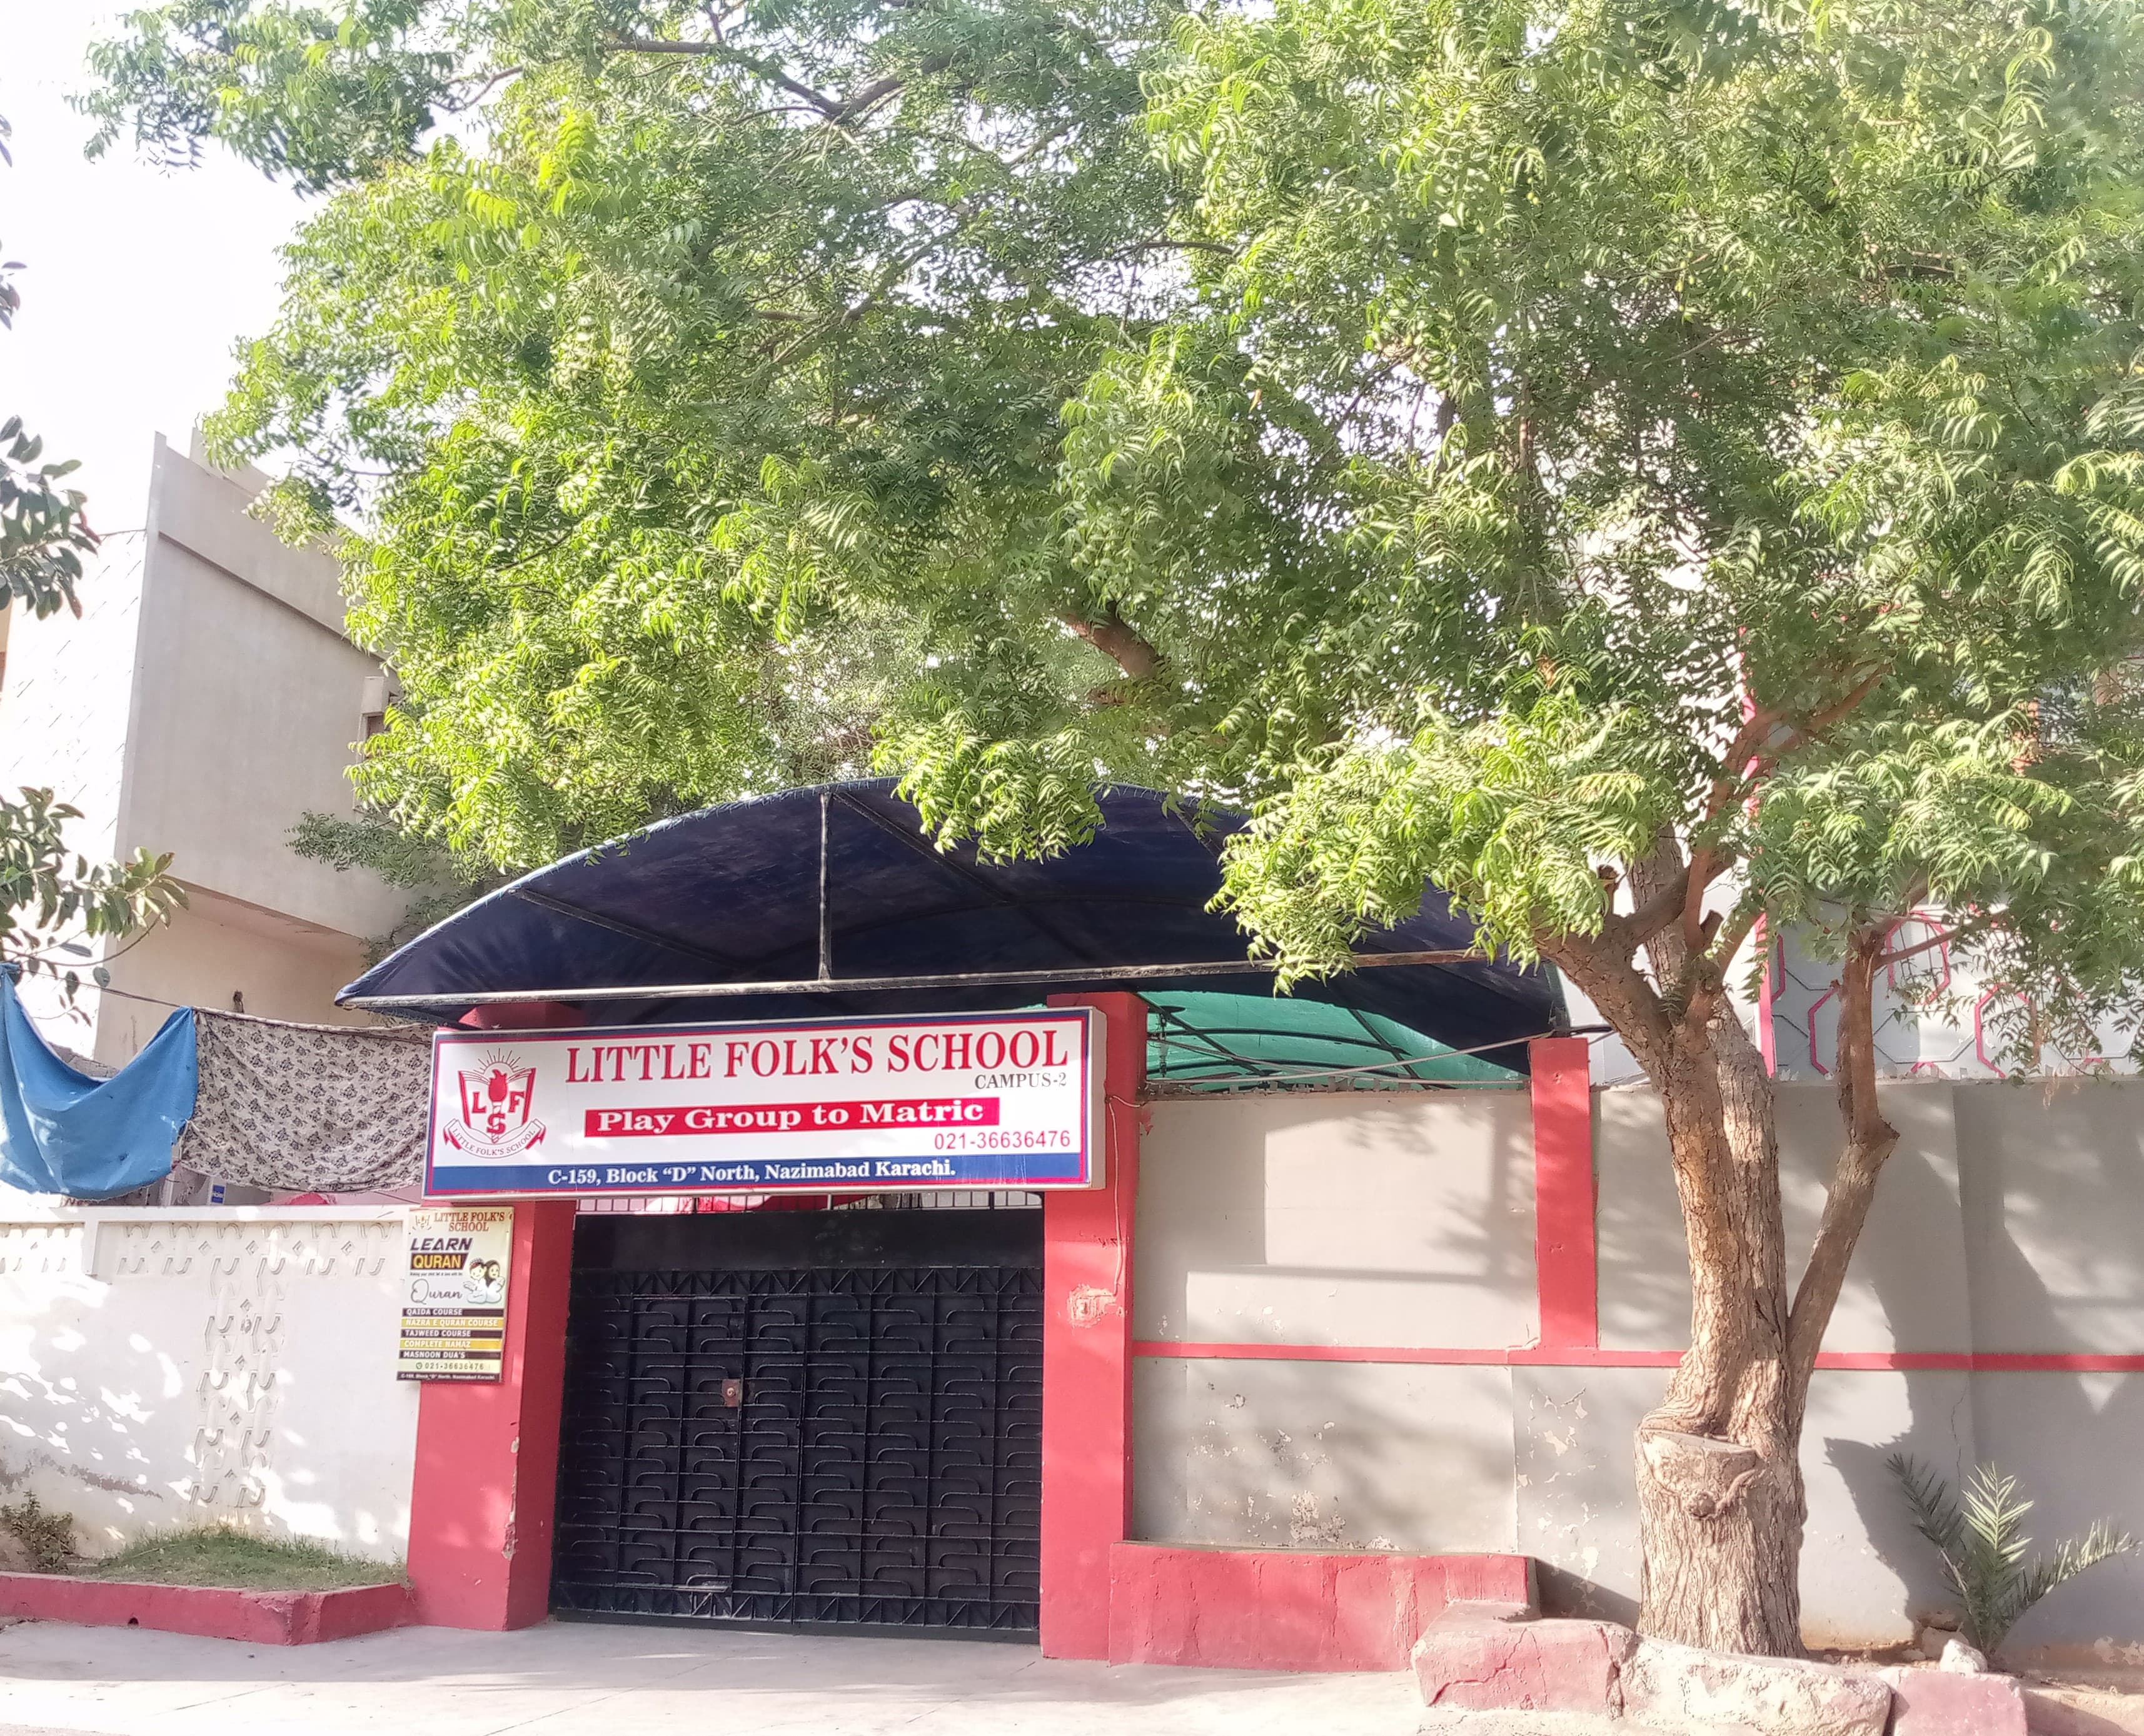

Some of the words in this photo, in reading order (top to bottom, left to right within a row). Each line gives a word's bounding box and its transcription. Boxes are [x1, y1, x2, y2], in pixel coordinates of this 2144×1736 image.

[566, 1041, 712, 1083] LITTLE
[724, 1036, 873, 1078] FOLK’S
[887, 1029, 1069, 1073] SCHOOL
[974, 1072, 1067, 1090] CAMPUS-2
[597, 1110, 676, 1136] Play
[685, 1106, 802, 1130] Group
[812, 1105, 849, 1125] to
[860, 1100, 984, 1123] Matric
[452, 1128, 474, 1151] LITTLE
[506, 1130, 536, 1153] SCHOOL
[934, 1130, 1071, 1150] 021-36636476
[548, 1167, 601, 1186] C-159,
[606, 1167, 658, 1183] Block
[700, 1164, 760, 1182] North,
[764, 1162, 870, 1180] Nazimabad
[875, 1158, 956, 1177] Karachi.
[434, 1212, 470, 1222] LITTLE
[448, 1222, 490, 1232] SCHOOL
[410, 1237, 473, 1251] LEARN
[413, 1254, 461, 1269] QURAN
[410, 1278, 463, 1305] Quran
[440, 1319, 466, 1327] QURAN
[404, 1340, 443, 1348] COMPLETE
[403, 1350, 442, 1358] MASNOON
